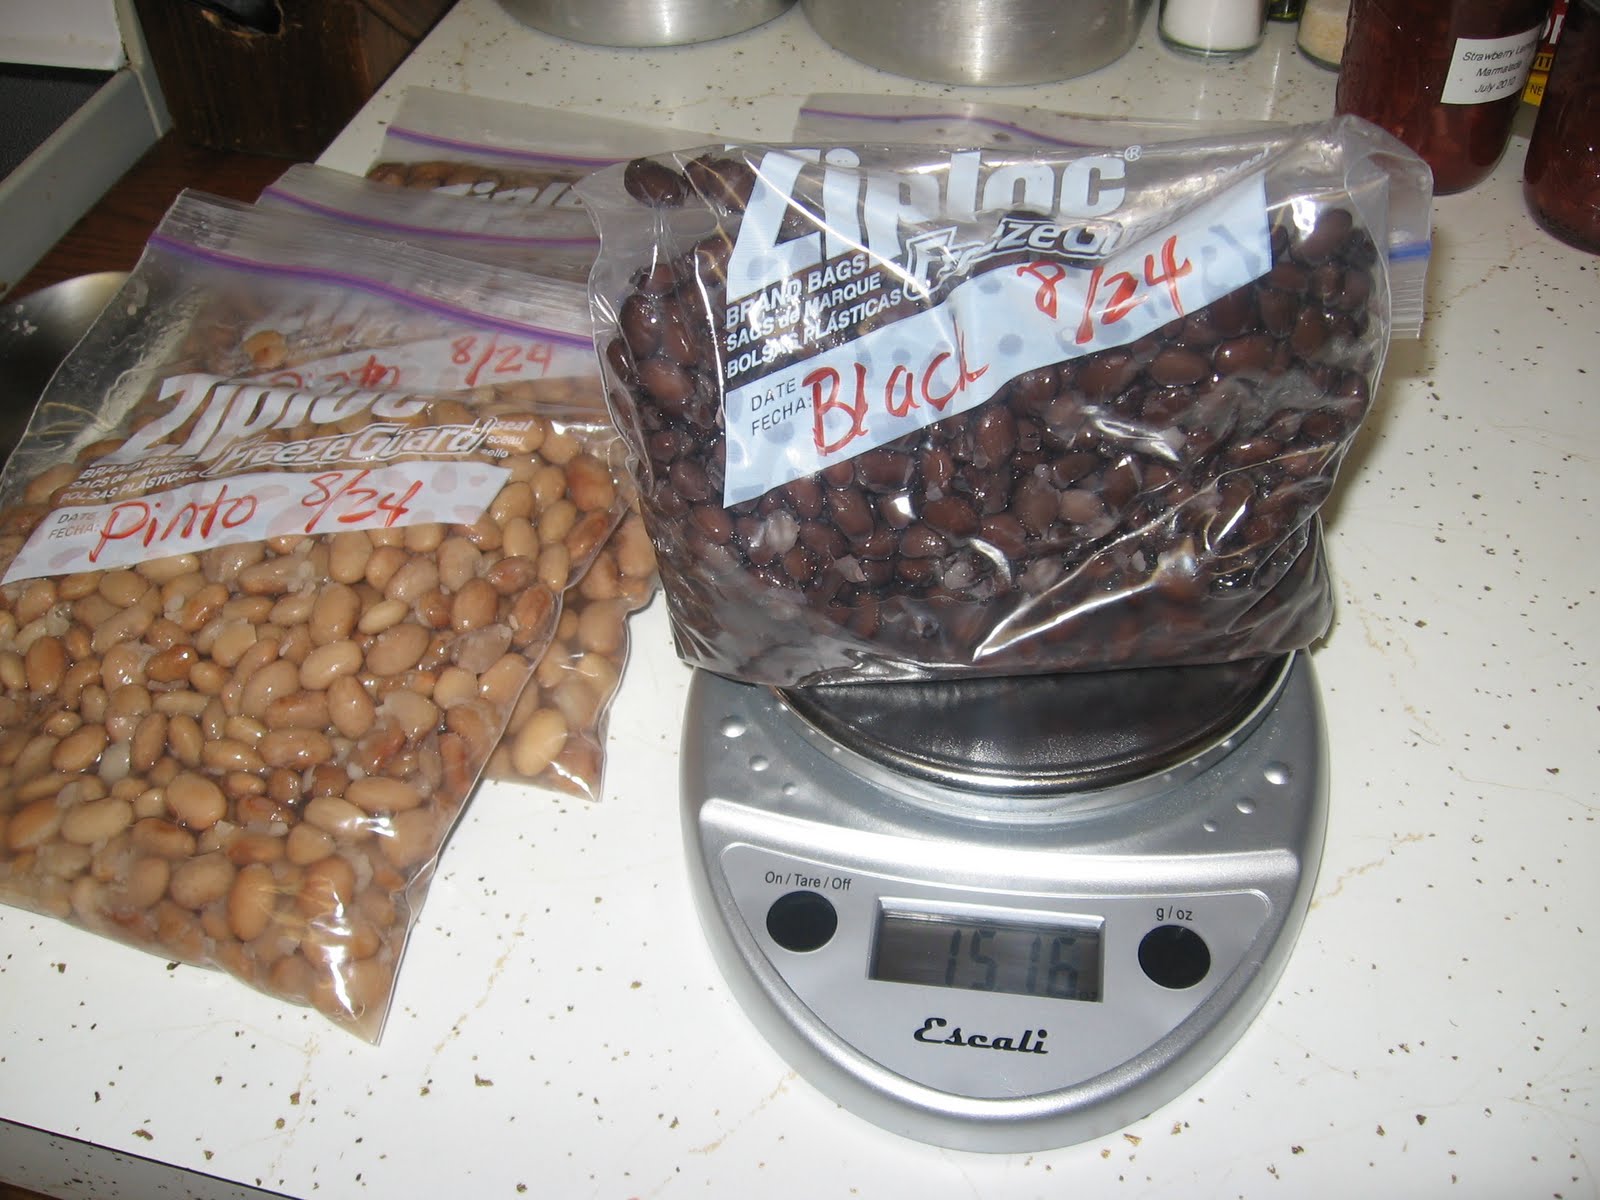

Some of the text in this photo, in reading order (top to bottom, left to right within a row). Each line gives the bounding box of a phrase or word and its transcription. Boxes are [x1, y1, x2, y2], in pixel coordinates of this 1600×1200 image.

[1462, 47, 1515, 61] Strawberry
[1474, 83, 1495, 93] July
[726, 254, 868, 330] BRAND BAGS
[803, 271, 881, 319] MARQUE
[1016, 236, 1192, 345] 8/24
[803, 287, 902, 345] PLÁSTICAS
[751, 377, 797, 411] DATE
[752, 396, 813, 436] FECHA:
[200, 414, 499, 479] FreezeGuard
[302, 470, 423, 533] 8/24
[764, 871, 783, 884] On
[793, 873, 821, 888] Tare
[831, 876, 852, 891] Off
[1155, 908, 1164, 922] g
[1176, 908, 1193, 921] oz
[913, 1017, 1050, 1055] Escali
